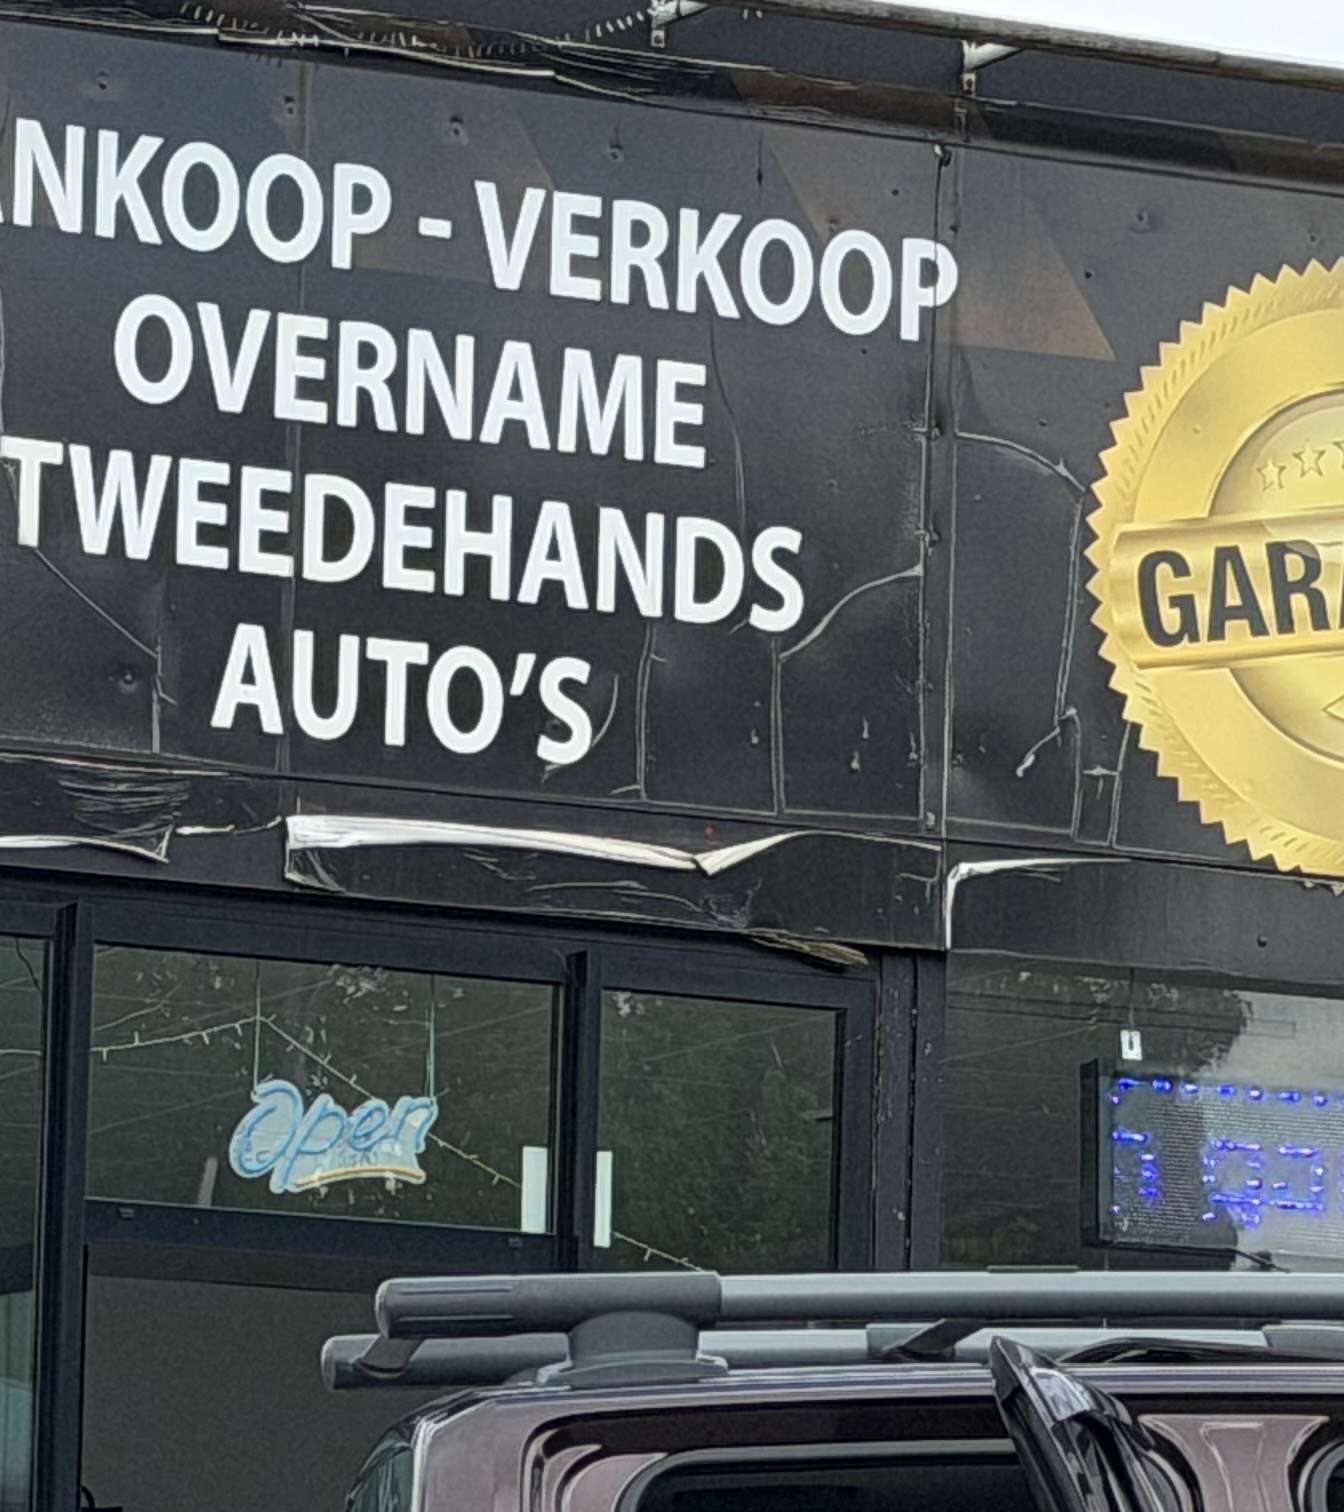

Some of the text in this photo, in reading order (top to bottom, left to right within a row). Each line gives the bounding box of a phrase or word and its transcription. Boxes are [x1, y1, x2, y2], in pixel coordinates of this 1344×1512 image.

[475, 180, 959, 343] VERKOOP
[114, 294, 708, 469] OVERNAME
[0, 435, 804, 634] TWEEDEHANDS
[211, 624, 593, 767] AUTO'S
[231, 1081, 437, 1194] Open
